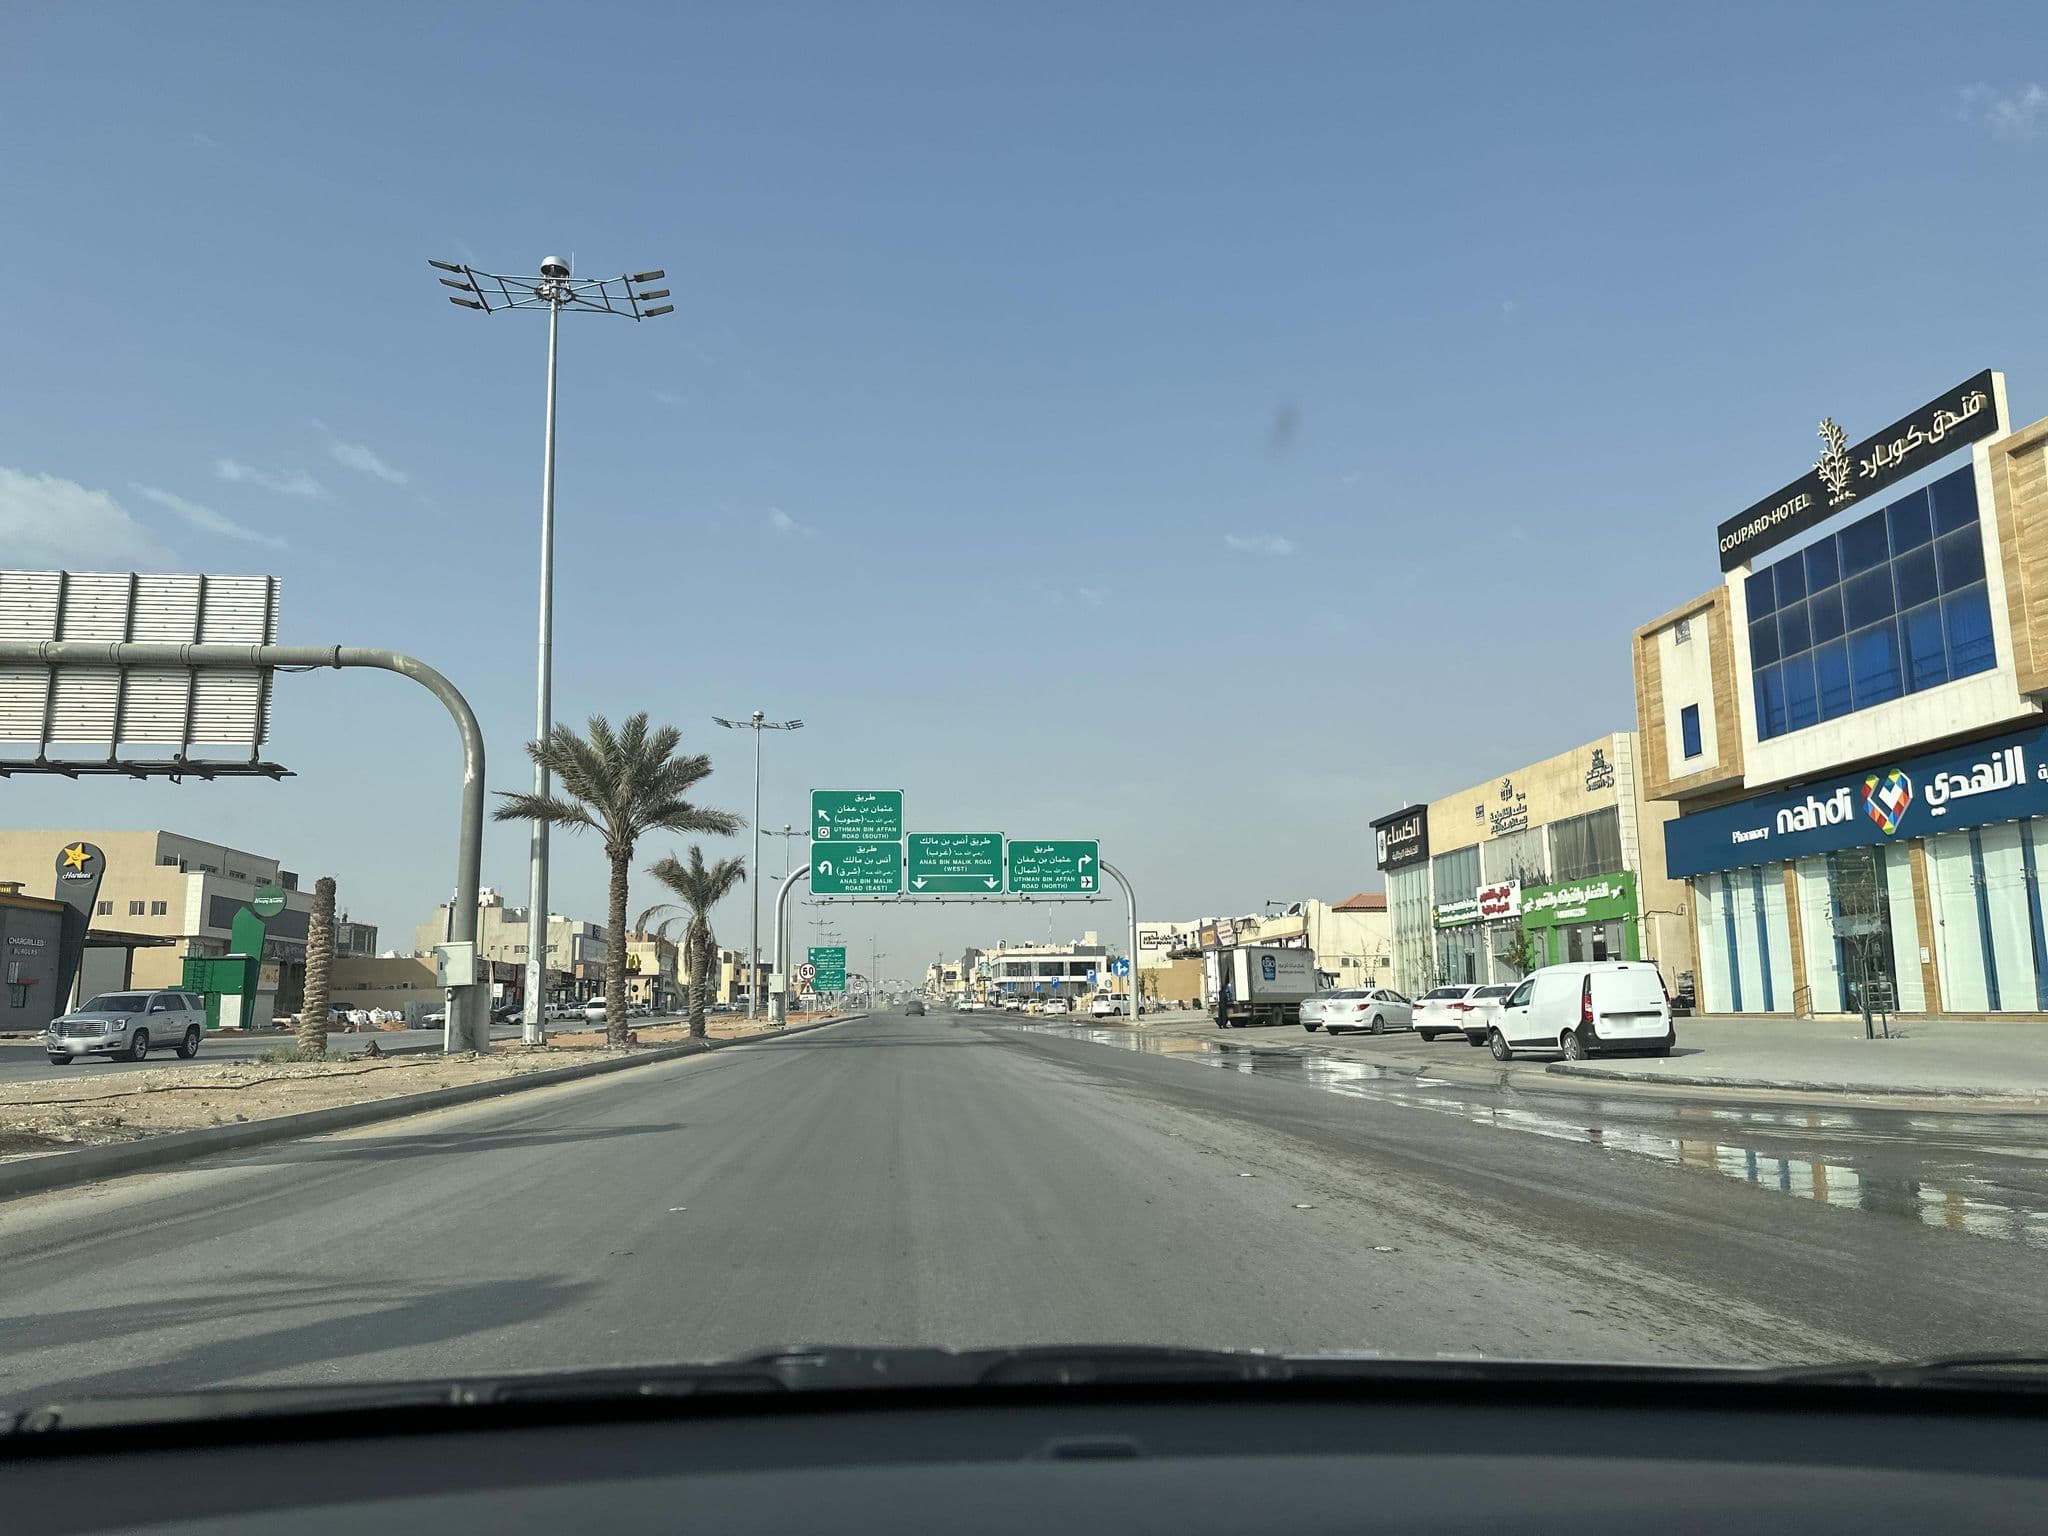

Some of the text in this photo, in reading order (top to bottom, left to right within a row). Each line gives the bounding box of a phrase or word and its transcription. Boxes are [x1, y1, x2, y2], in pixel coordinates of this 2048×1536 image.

[1860, 391, 1986, 478] فندق كوبارد
[1772, 494, 1810, 525] HOTEL
[1925, 746, 2026, 816] النهدي
[855, 794, 876, 802] طريق
[838, 805, 857, 813] عفان
[871, 805, 893, 813] عثمان
[834, 815, 864, 824] (جنوب)
[1732, 787, 1853, 844] Pharmacy nahdi
[1386, 816, 1420, 846] الكساء
[970, 837, 991, 846] طريق
[856, 845, 877, 854] طريق
[1034, 845, 1054, 853] طريق
[876, 854, 891, 864] أنس
[836, 866, 860, 876] (شرق)
[1014, 865, 1040, 875] (شمال)
[803, 966, 814, 976] 50
